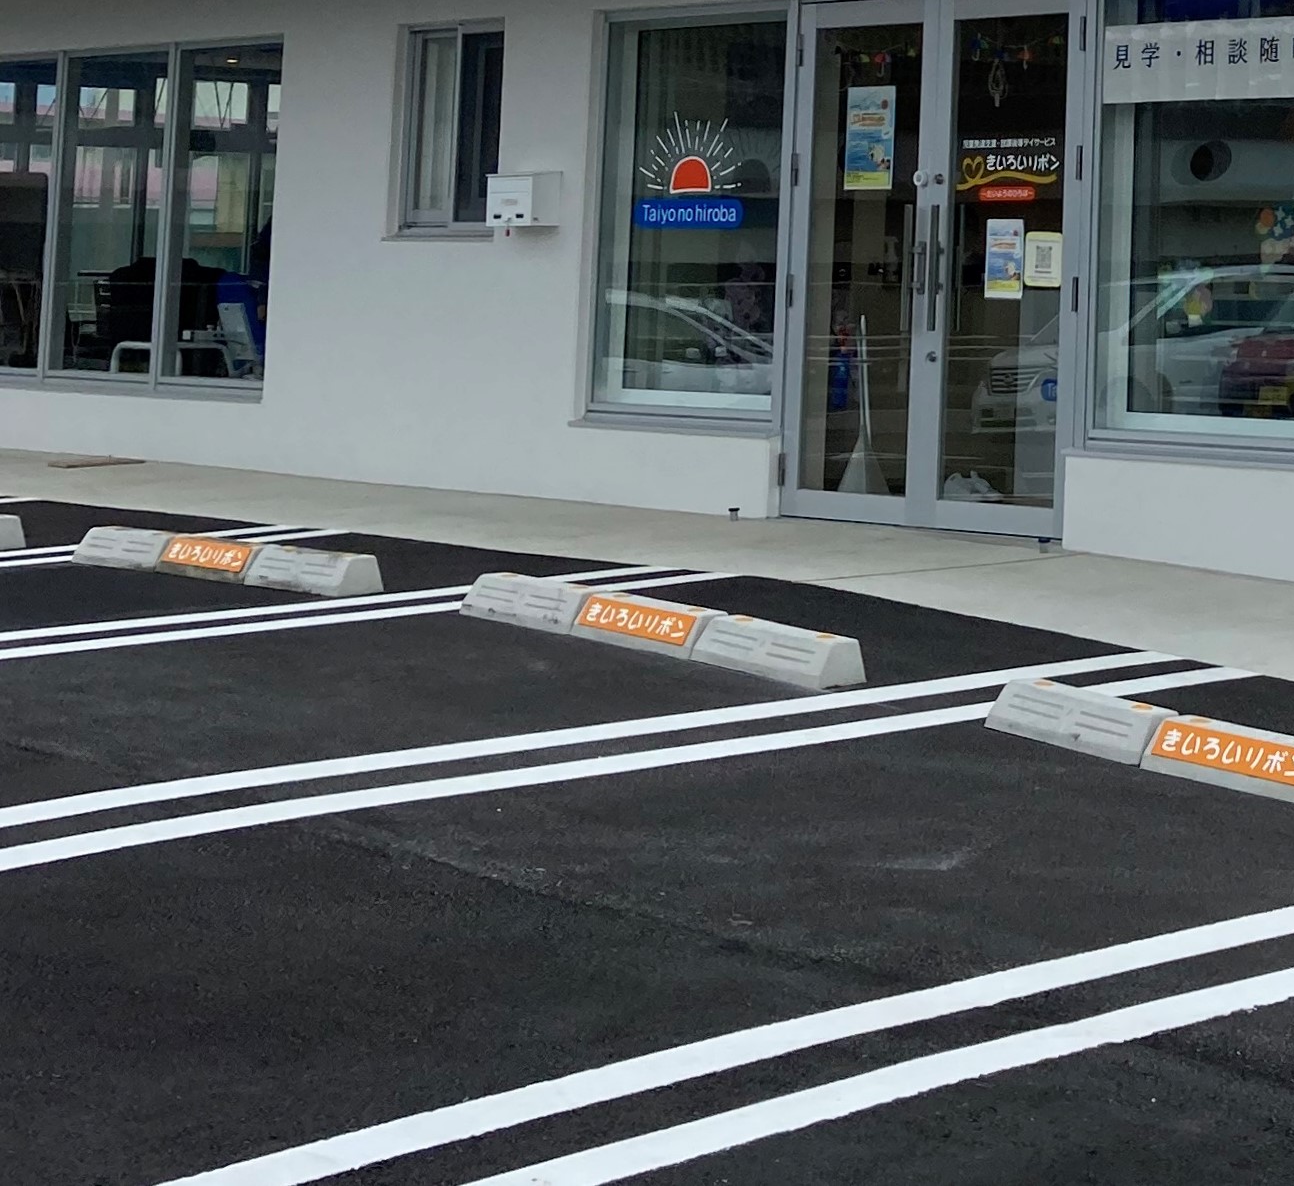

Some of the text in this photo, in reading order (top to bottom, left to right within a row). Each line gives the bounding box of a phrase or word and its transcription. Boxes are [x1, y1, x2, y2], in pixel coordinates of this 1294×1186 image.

[986, 153, 1060, 171] きいろいリボン
[642, 204, 737, 225] Taiyo no hiroba
[168, 542, 242, 567] きいろいリボン
[586, 602, 684, 638] きいろいリボン
